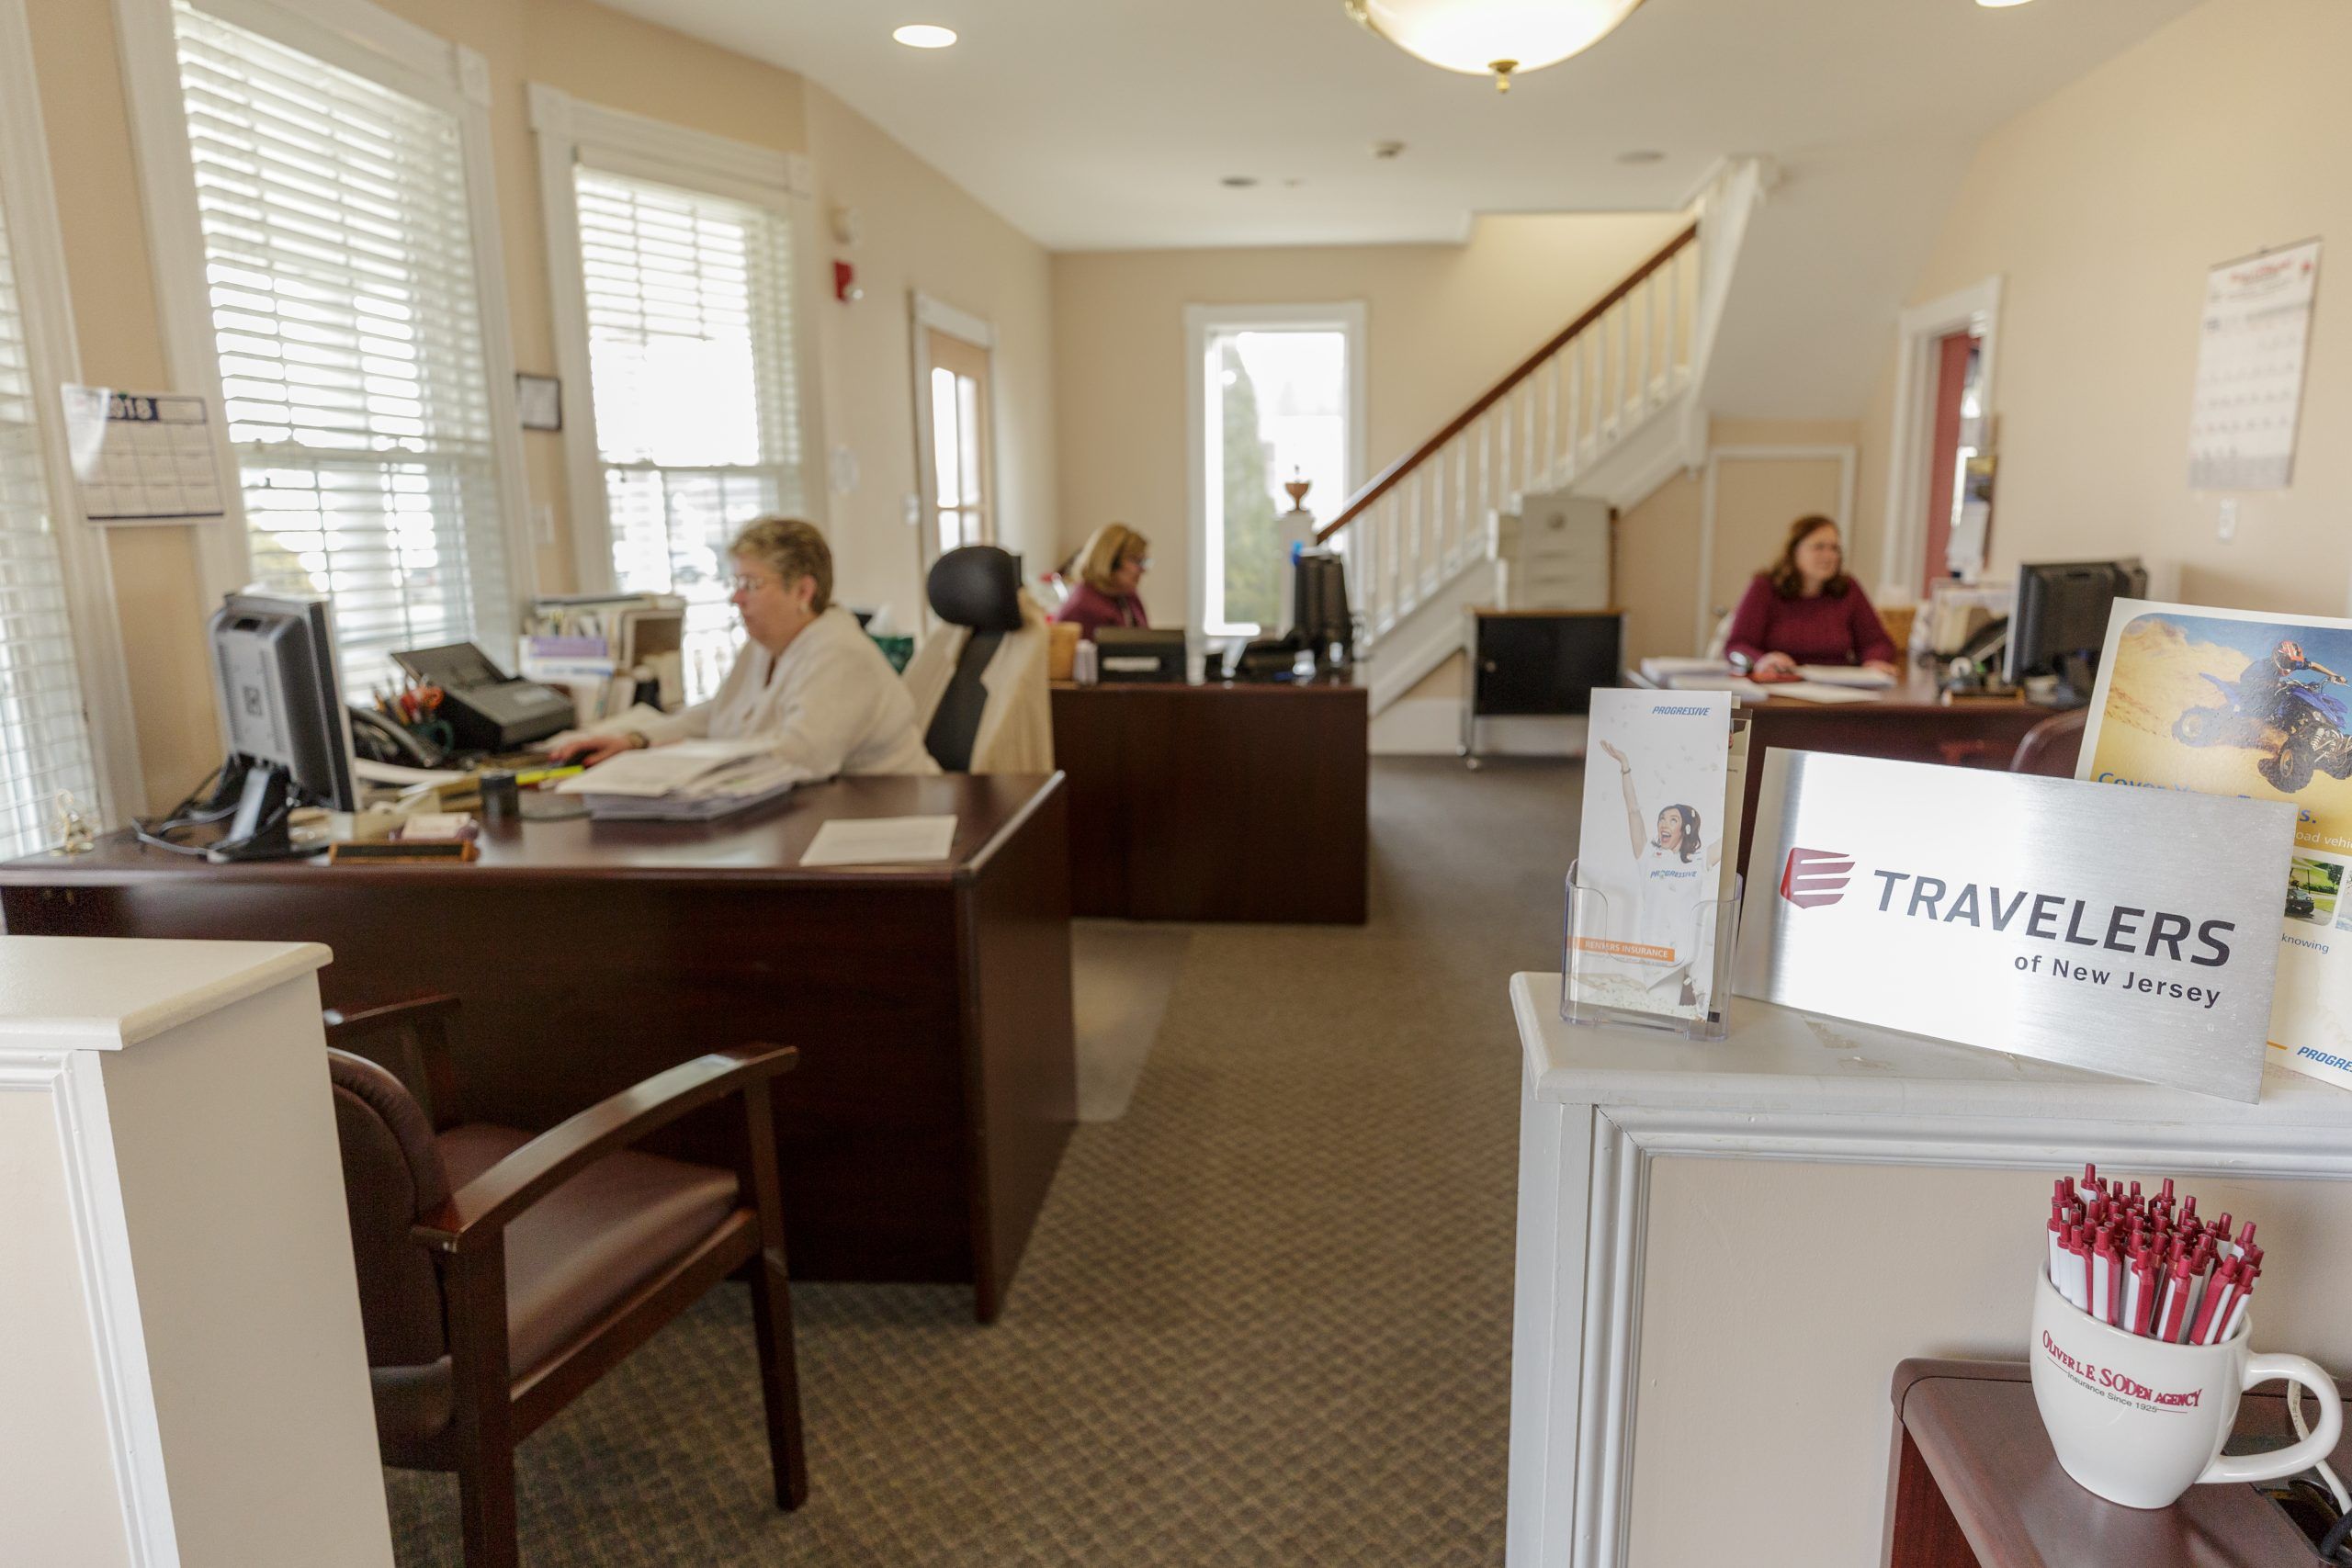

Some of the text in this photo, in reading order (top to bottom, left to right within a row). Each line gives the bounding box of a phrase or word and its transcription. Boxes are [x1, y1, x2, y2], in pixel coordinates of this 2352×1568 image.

[1652, 705, 1711, 716] PROGRESSIVE
[1874, 870, 2236, 968] TRAVELERS
[1585, 940, 1669, 958] RENTERS INSURANCE
[2281, 933, 2330, 954] knowing
[2014, 954, 2222, 1010] of New Jersey
[2297, 1046, 2352, 1073] PROGRE
[2042, 1329, 2075, 1371] OLIVER
[2098, 1368, 2154, 1402] SODEN
[2154, 1388, 2203, 1407] AGENCY
[2067, 1371, 2158, 1414] Insurance Since 1925
